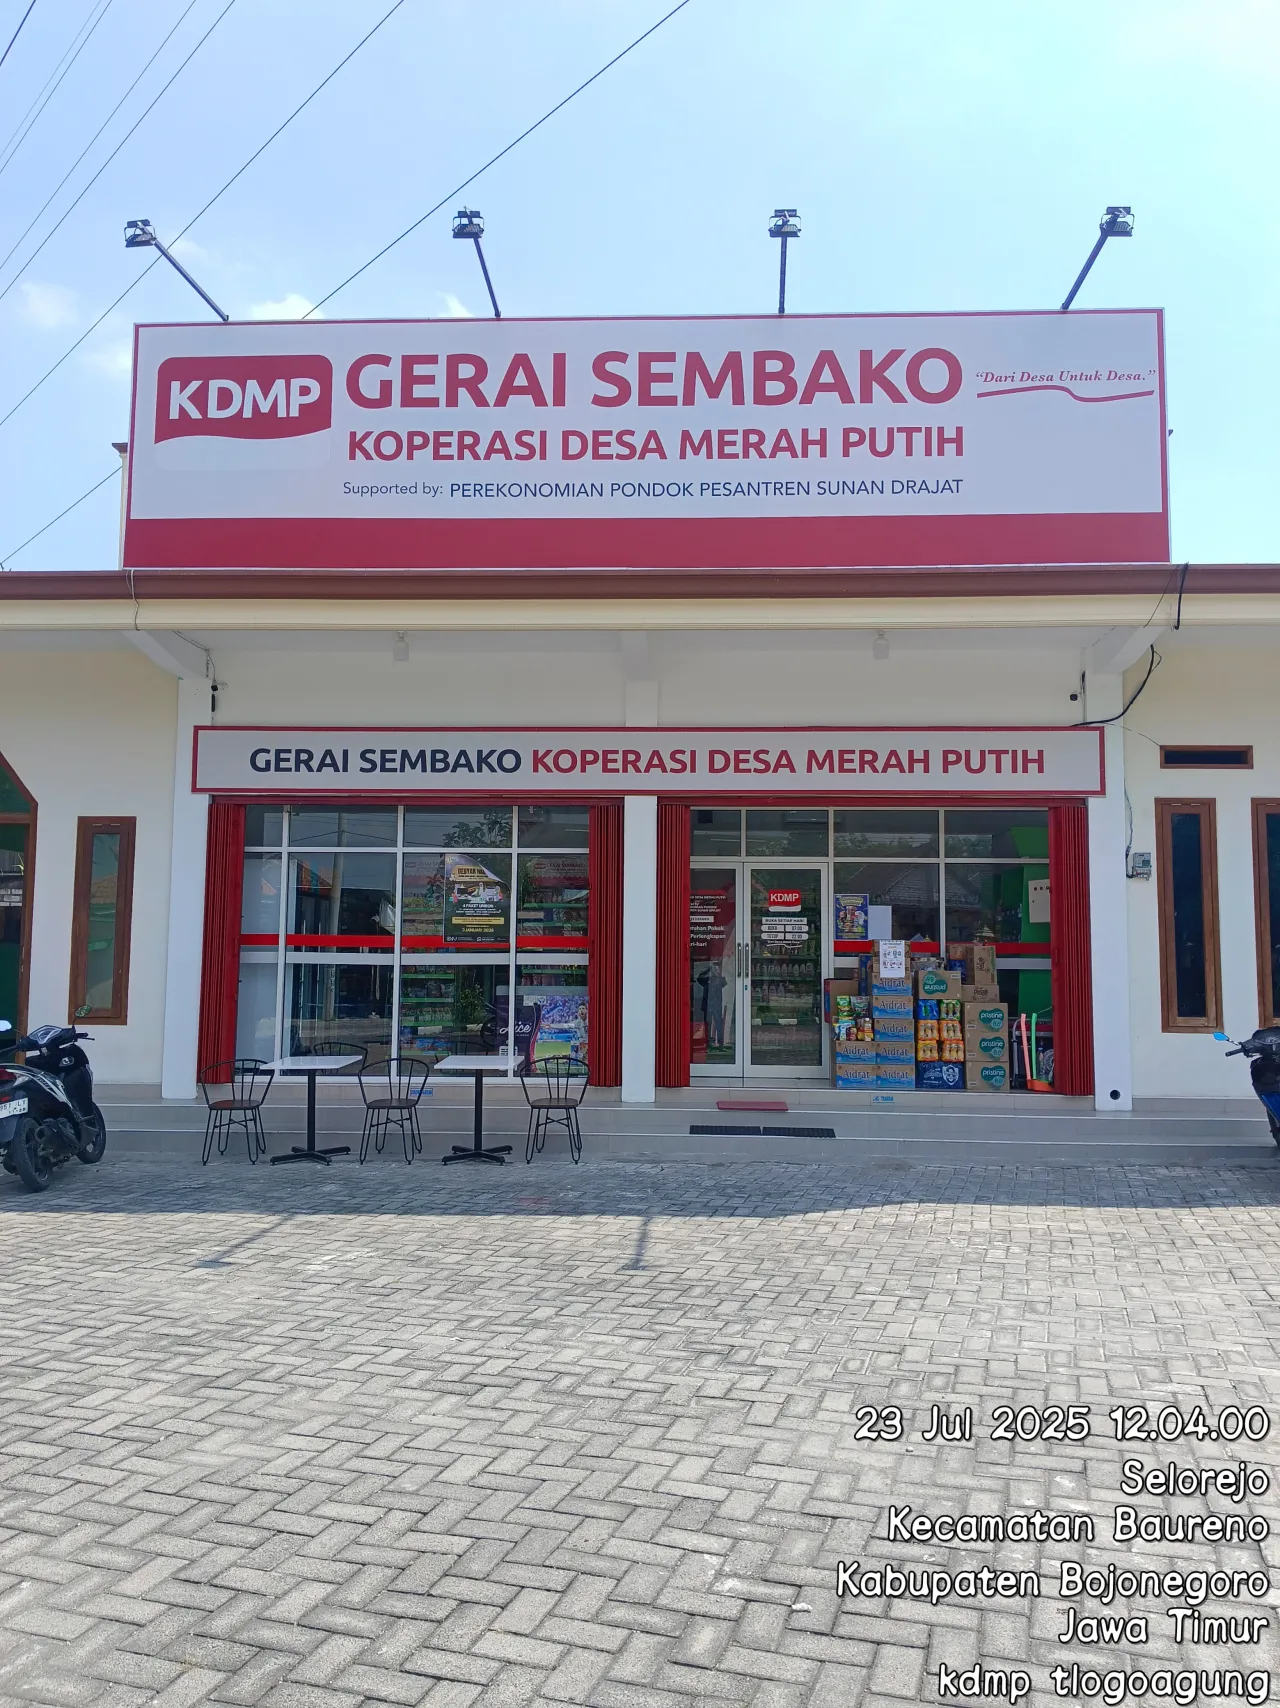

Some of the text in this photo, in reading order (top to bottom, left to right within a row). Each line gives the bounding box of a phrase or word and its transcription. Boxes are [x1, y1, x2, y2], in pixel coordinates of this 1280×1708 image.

[346, 348, 962, 409] GERAI SEMBAKO
[1019, 371, 1054, 383] Desa
[1058, 370, 1103, 382] Untuk
[169, 378, 321, 420] KDMP
[348, 426, 963, 461] KOPERASI DESA MERAH PUTIH
[343, 479, 964, 498] Supported by: PEREKONOMIAN PONDOK PESANTREN SUNAN DRAJAT
[250, 748, 1045, 774] GERAI SEMBAKO KOPERASI DESA MERAH PUTIH
[770, 894, 799, 902] KDMP
[880, 1000, 906, 1010] Aidrat
[980, 1012, 1003, 1020] pristine
[880, 1024, 907, 1034] Aidrat
[842, 1046, 869, 1056] Aidrat
[881, 1046, 908, 1057] Aidrat
[843, 1069, 870, 1079] Aidrat
[882, 1069, 908, 1080] Aidrat
